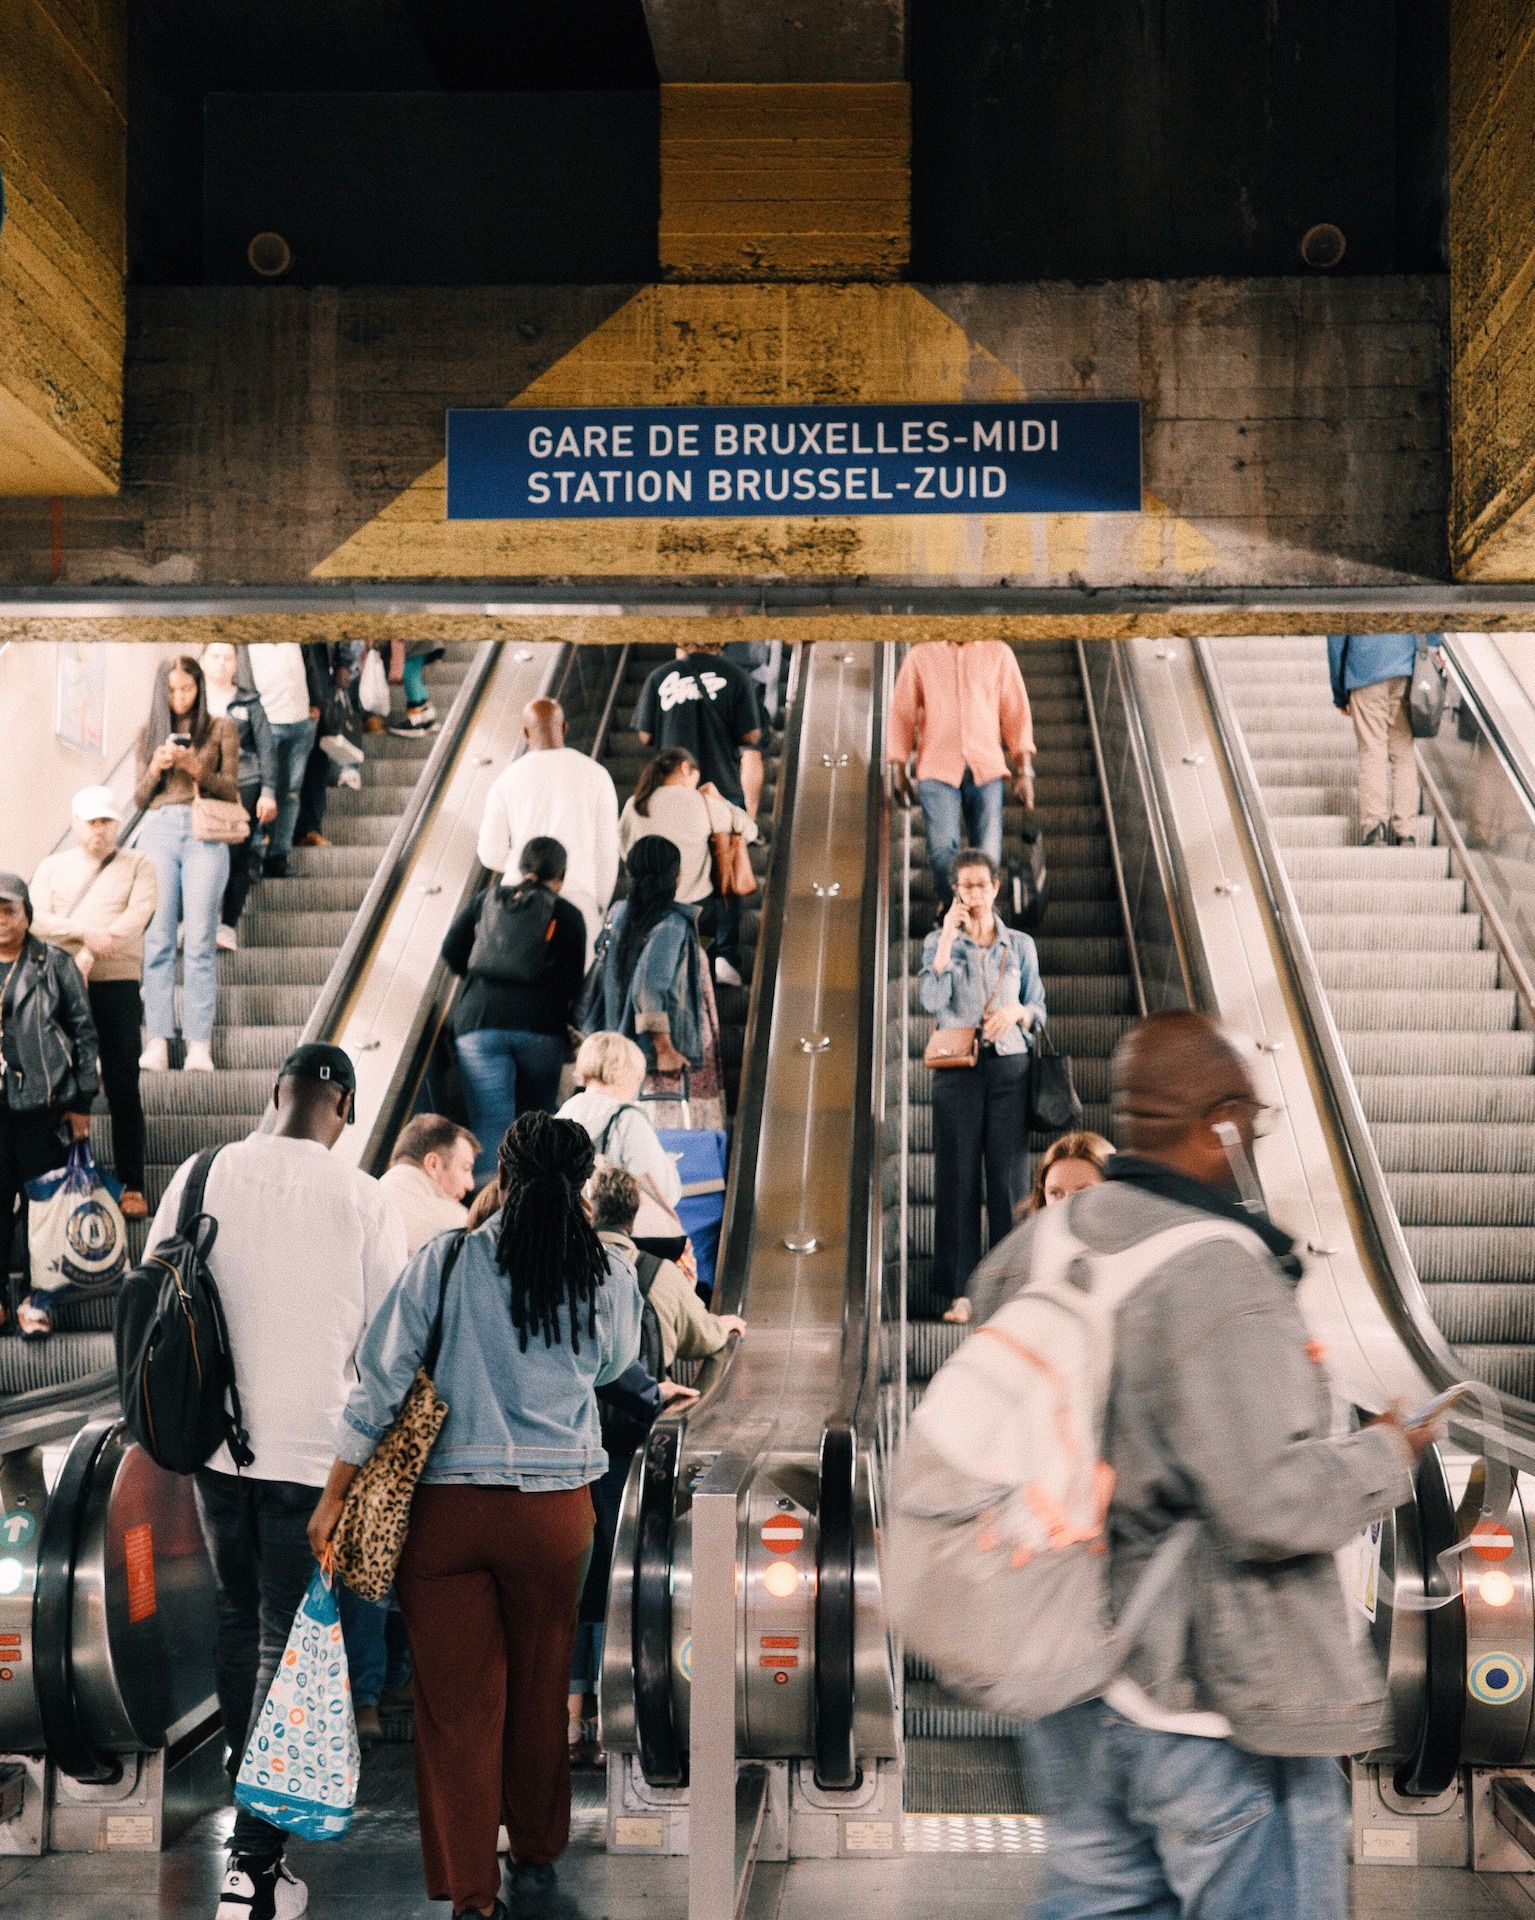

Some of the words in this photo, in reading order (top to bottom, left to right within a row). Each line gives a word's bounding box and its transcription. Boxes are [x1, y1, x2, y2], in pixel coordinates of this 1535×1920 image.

[528, 425, 634, 458] GARE
[649, 424, 700, 457] DE
[714, 420, 1059, 456] BRUXELLES-MIDI
[527, 470, 692, 504] STATION
[708, 466, 1007, 502] BRUSSEL-ZUID
